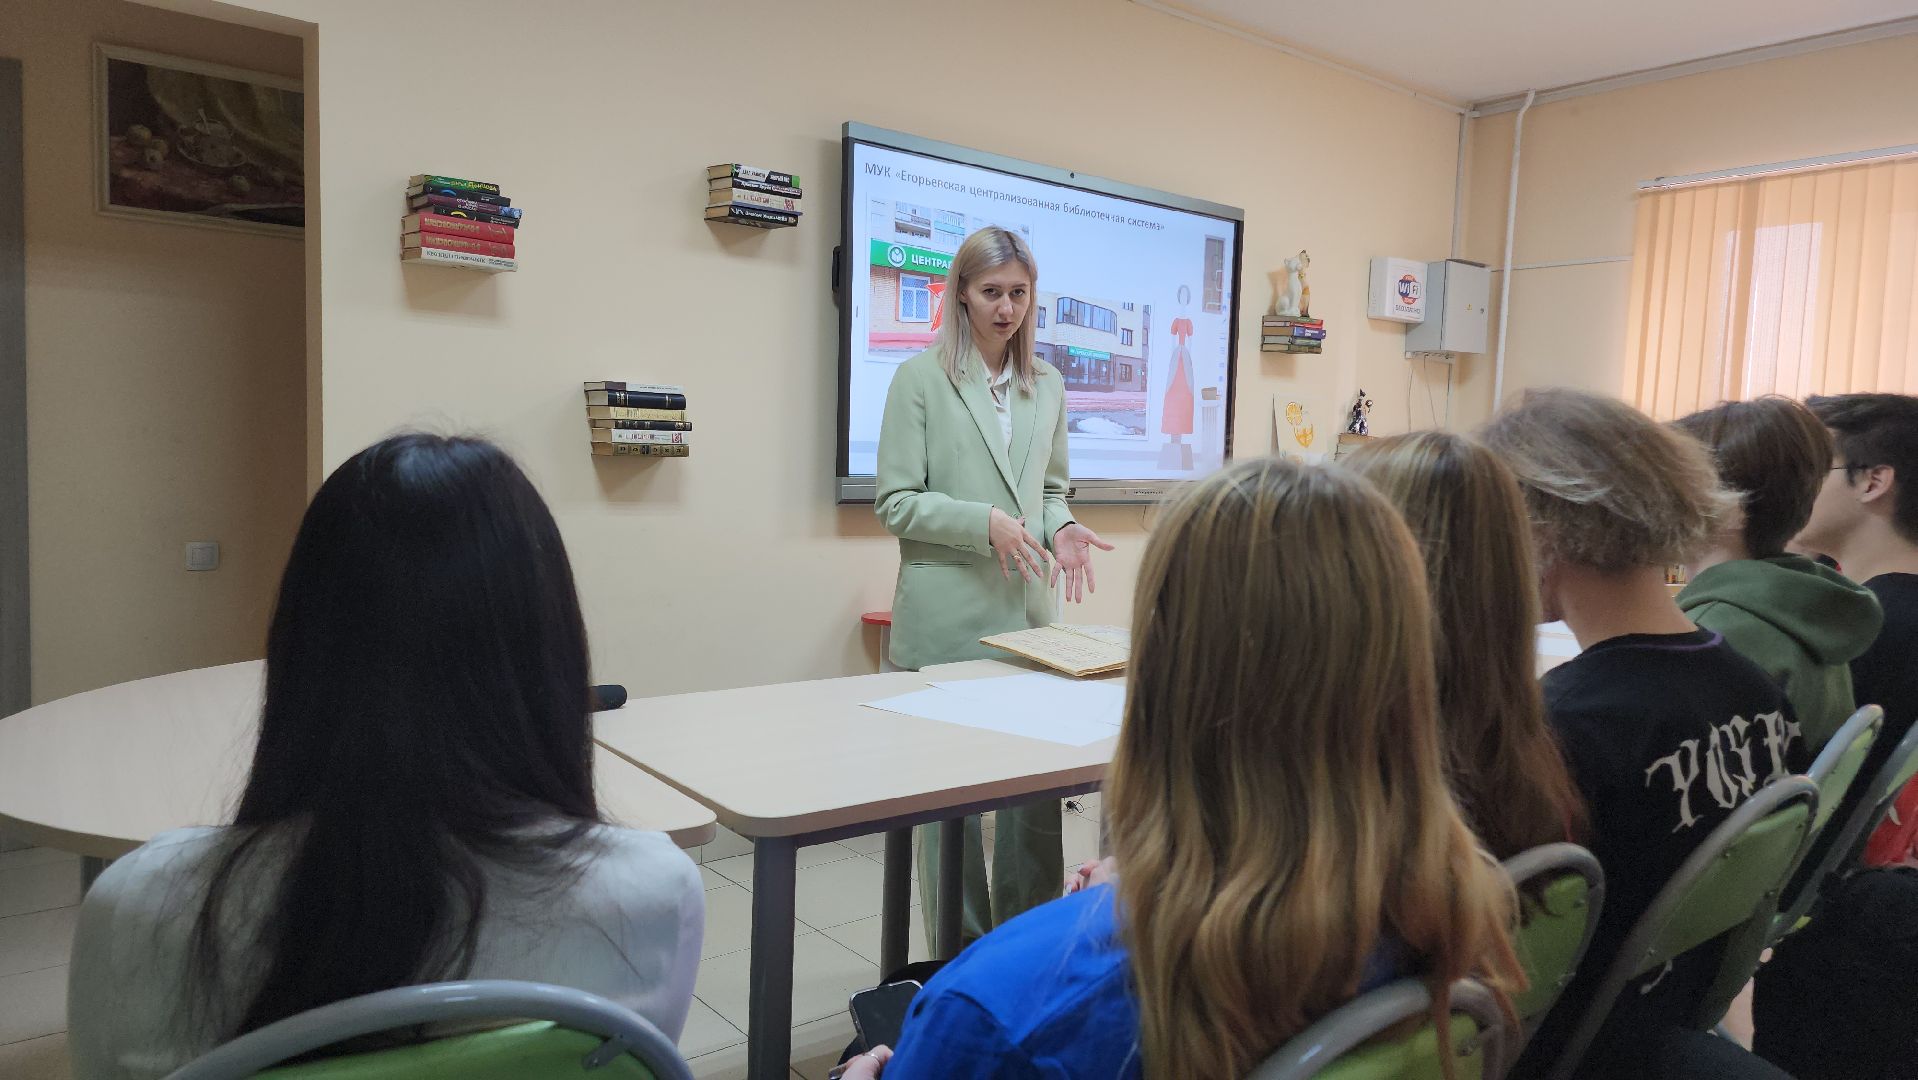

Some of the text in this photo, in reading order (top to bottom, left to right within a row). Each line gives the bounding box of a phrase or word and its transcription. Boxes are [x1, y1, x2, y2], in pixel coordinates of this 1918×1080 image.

[865, 162, 1165, 232] МУК «Егорьевская централизованная библиотечная система»
